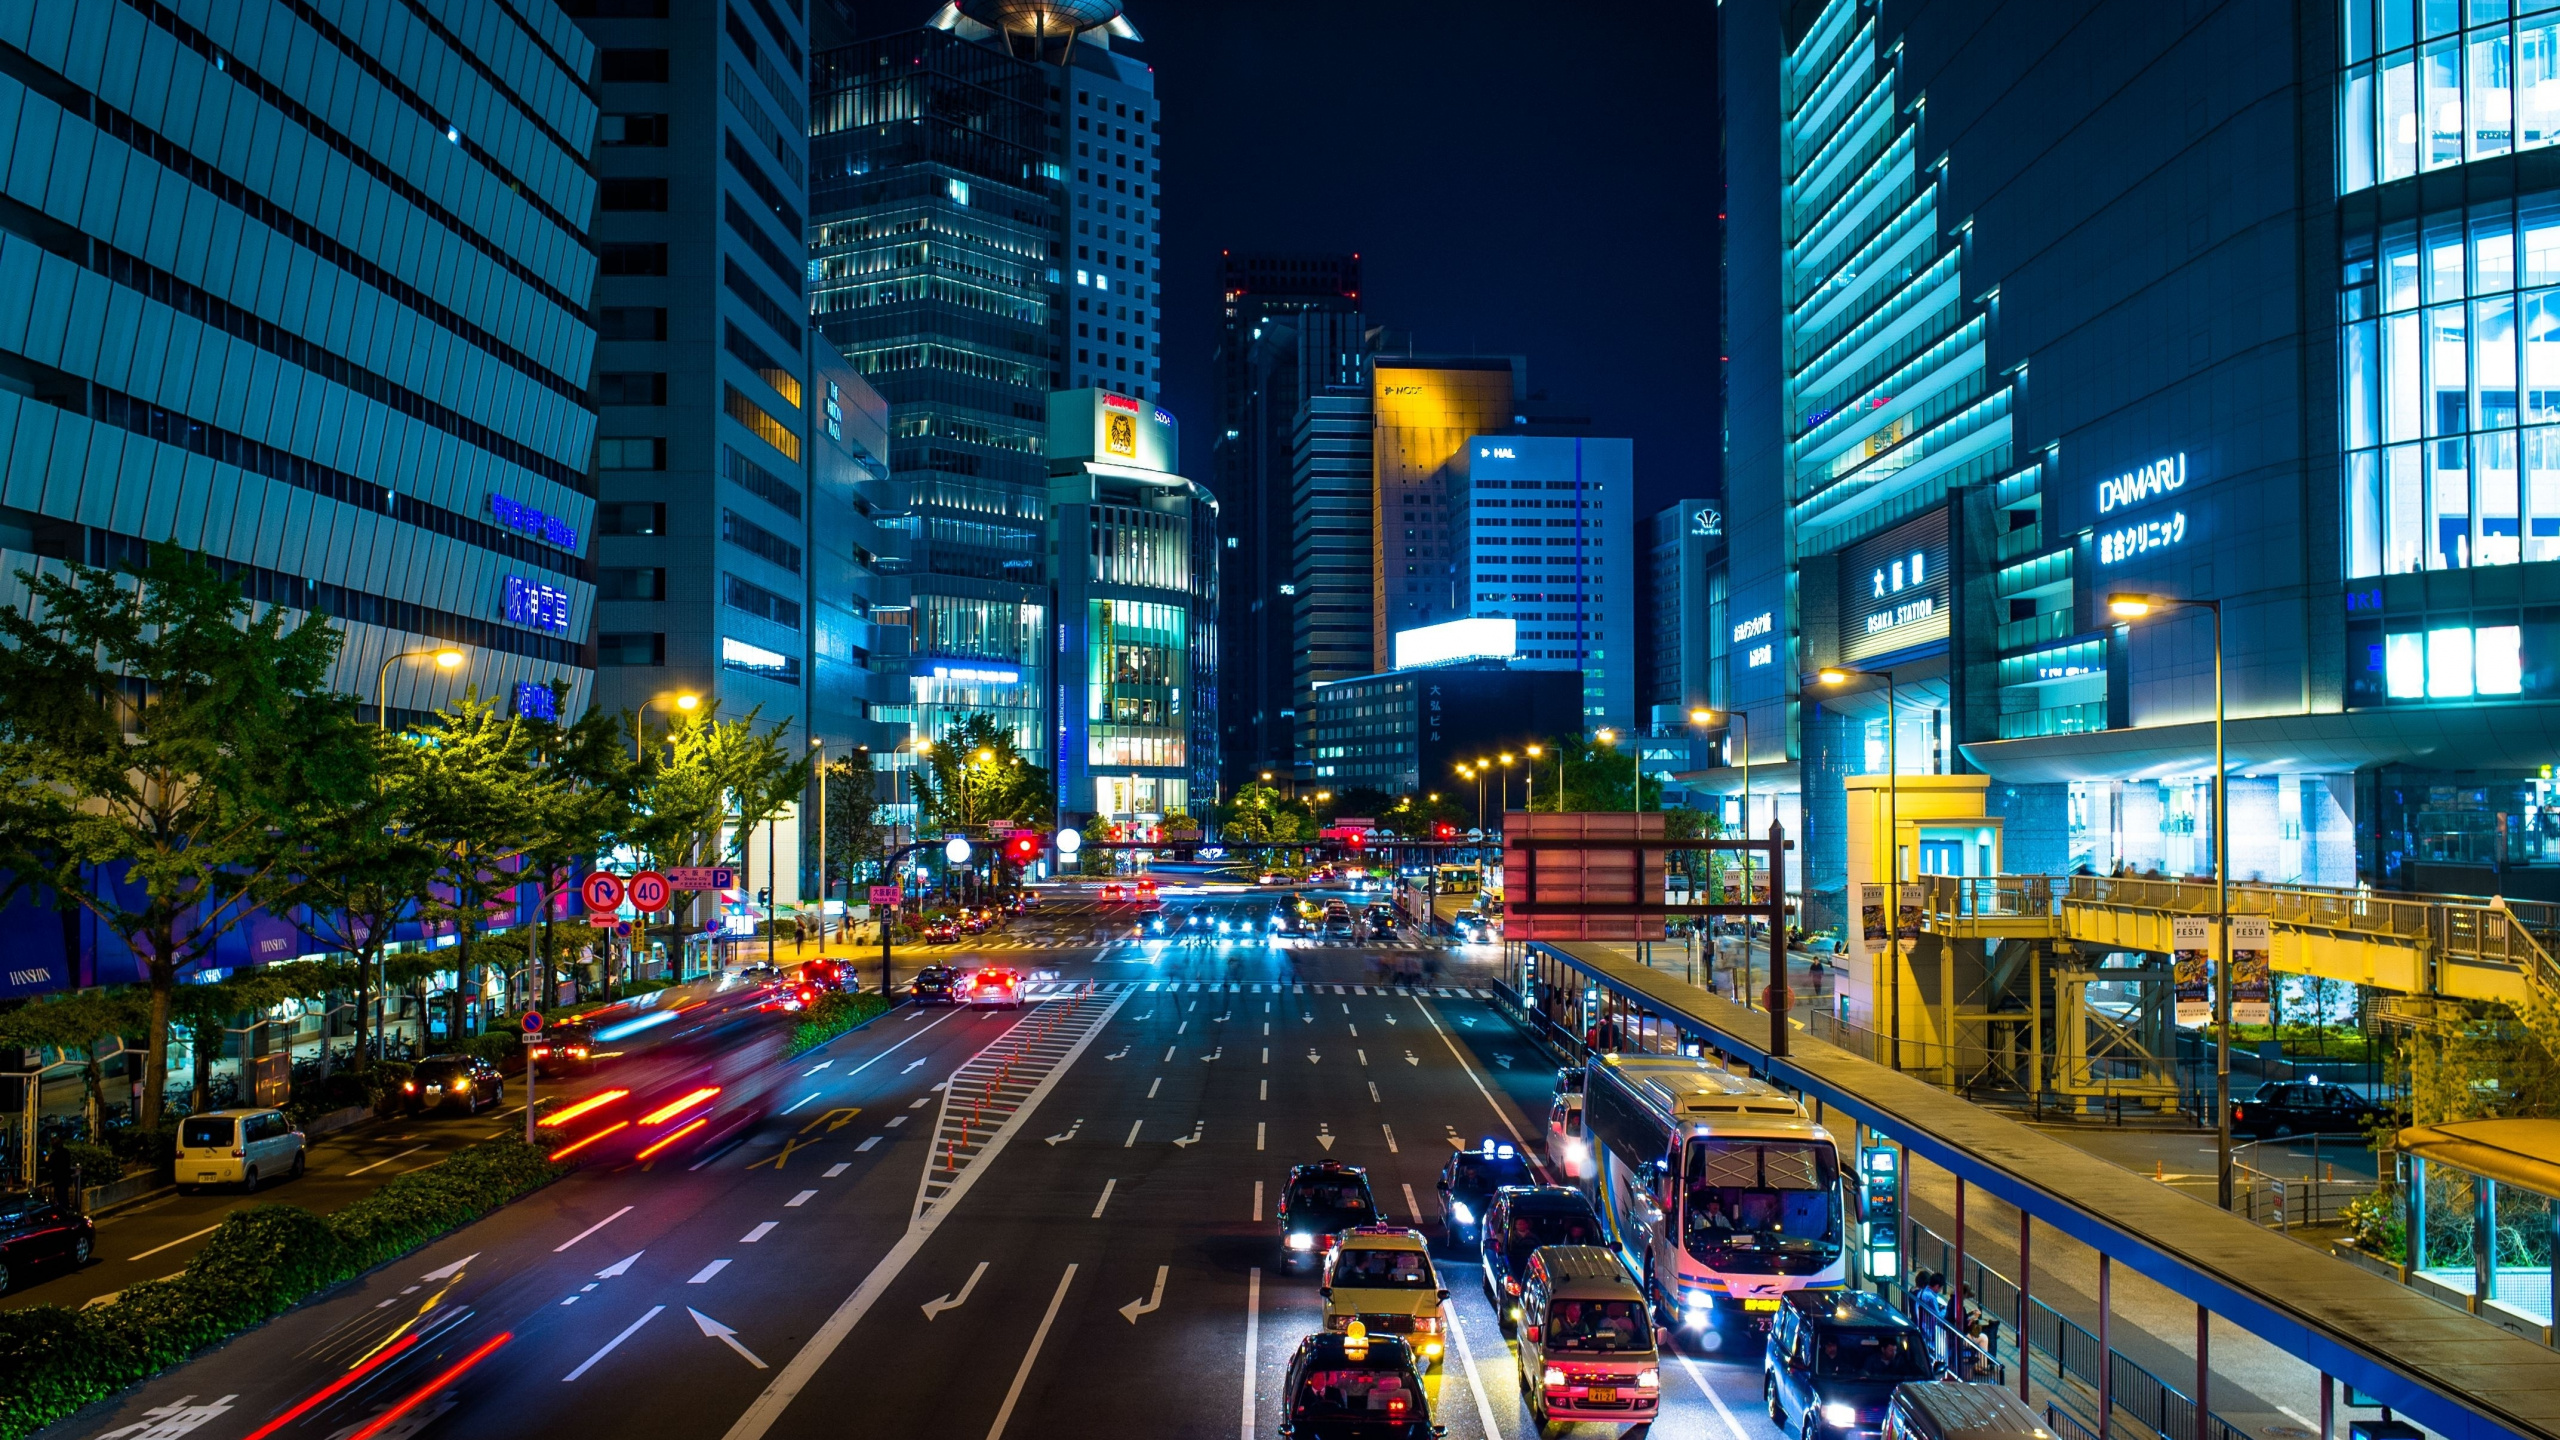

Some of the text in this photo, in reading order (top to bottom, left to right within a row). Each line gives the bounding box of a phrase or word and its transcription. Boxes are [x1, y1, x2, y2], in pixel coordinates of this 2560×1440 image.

[1493, 448, 1516, 459] HAL
[2099, 451, 2186, 514] DAIMARU
[505, 574, 568, 633] 阪神電車
[1867, 598, 1932, 634] OSAKA STATION
[1430, 684, 1441, 742] 大弘ビル
[717, 872, 728, 886] P
[637, 882, 660, 901] 40
[883, 908, 890, 918] P
[2176, 928, 2205, 936] FESTA
[2236, 928, 2265, 936] FESTA
[261, 937, 288, 953] HANSHIN
[9, 967, 51, 986] HANSHIN
